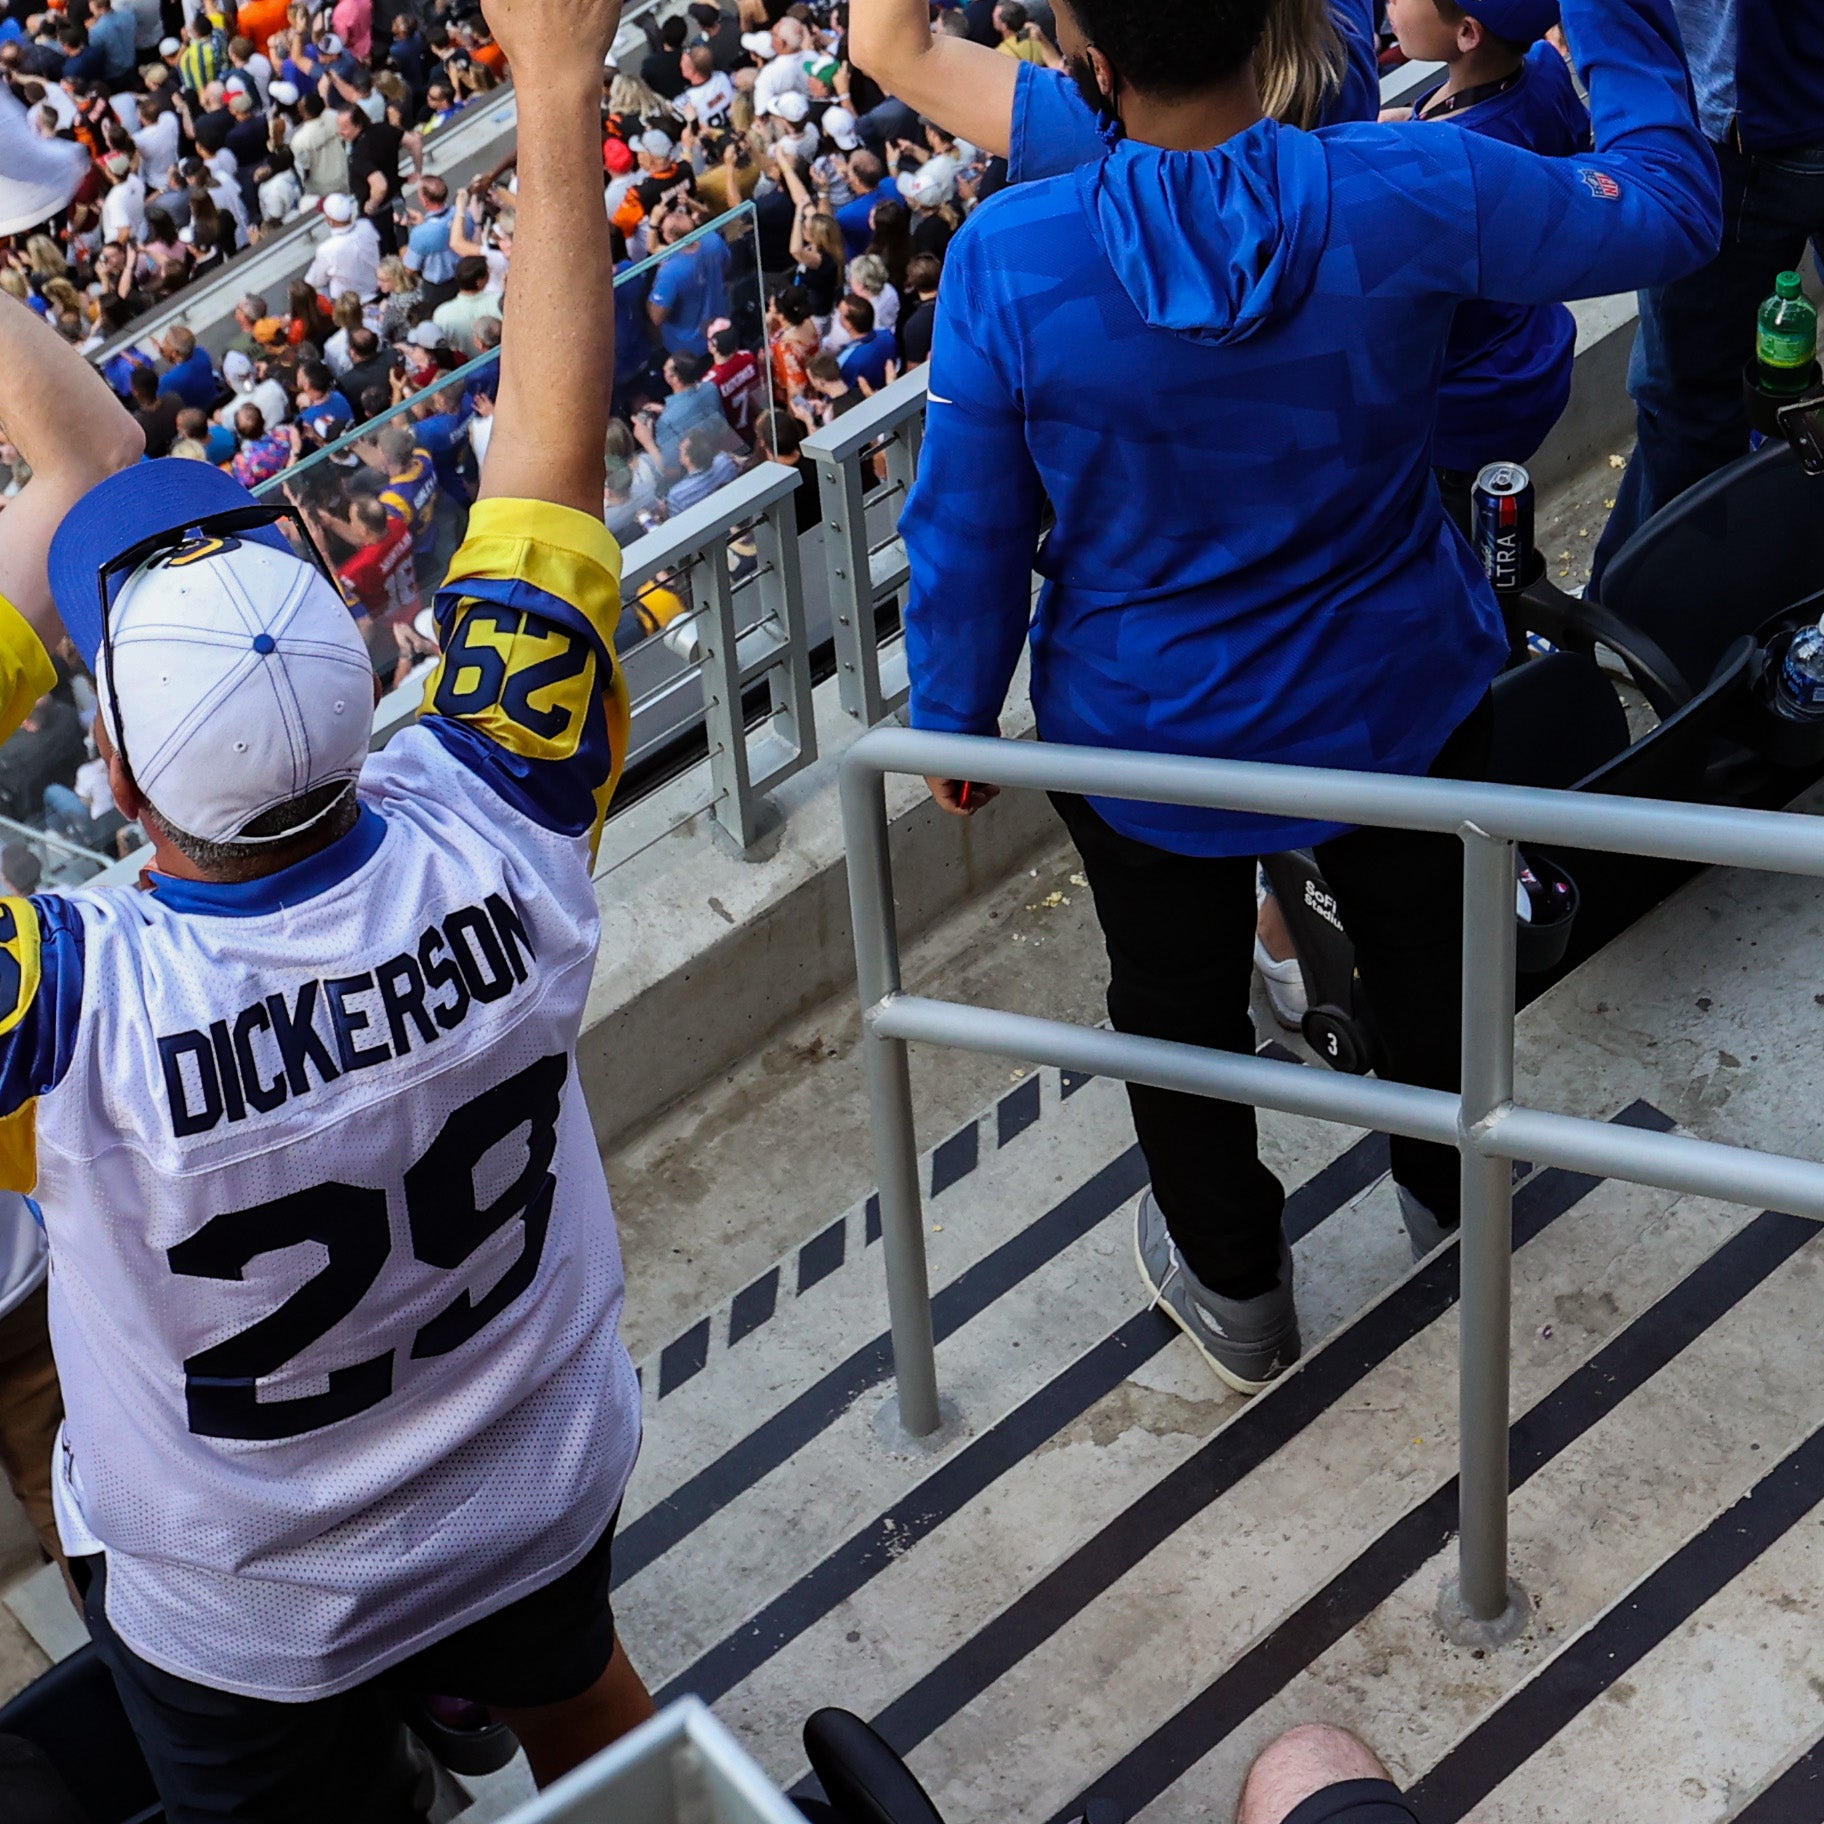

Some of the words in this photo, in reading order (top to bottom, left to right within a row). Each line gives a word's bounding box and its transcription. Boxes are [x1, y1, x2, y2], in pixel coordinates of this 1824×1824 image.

[1496, 532, 1516, 588] LTRA
[434, 602, 592, 740] 29
[1304, 893, 1344, 932] Stadiu
[1305, 880, 1337, 914] SoFi
[156, 892, 536, 1138] DICKERSON
[1327, 1032, 1338, 1057] 3
[166, 1051, 568, 1440] 29
